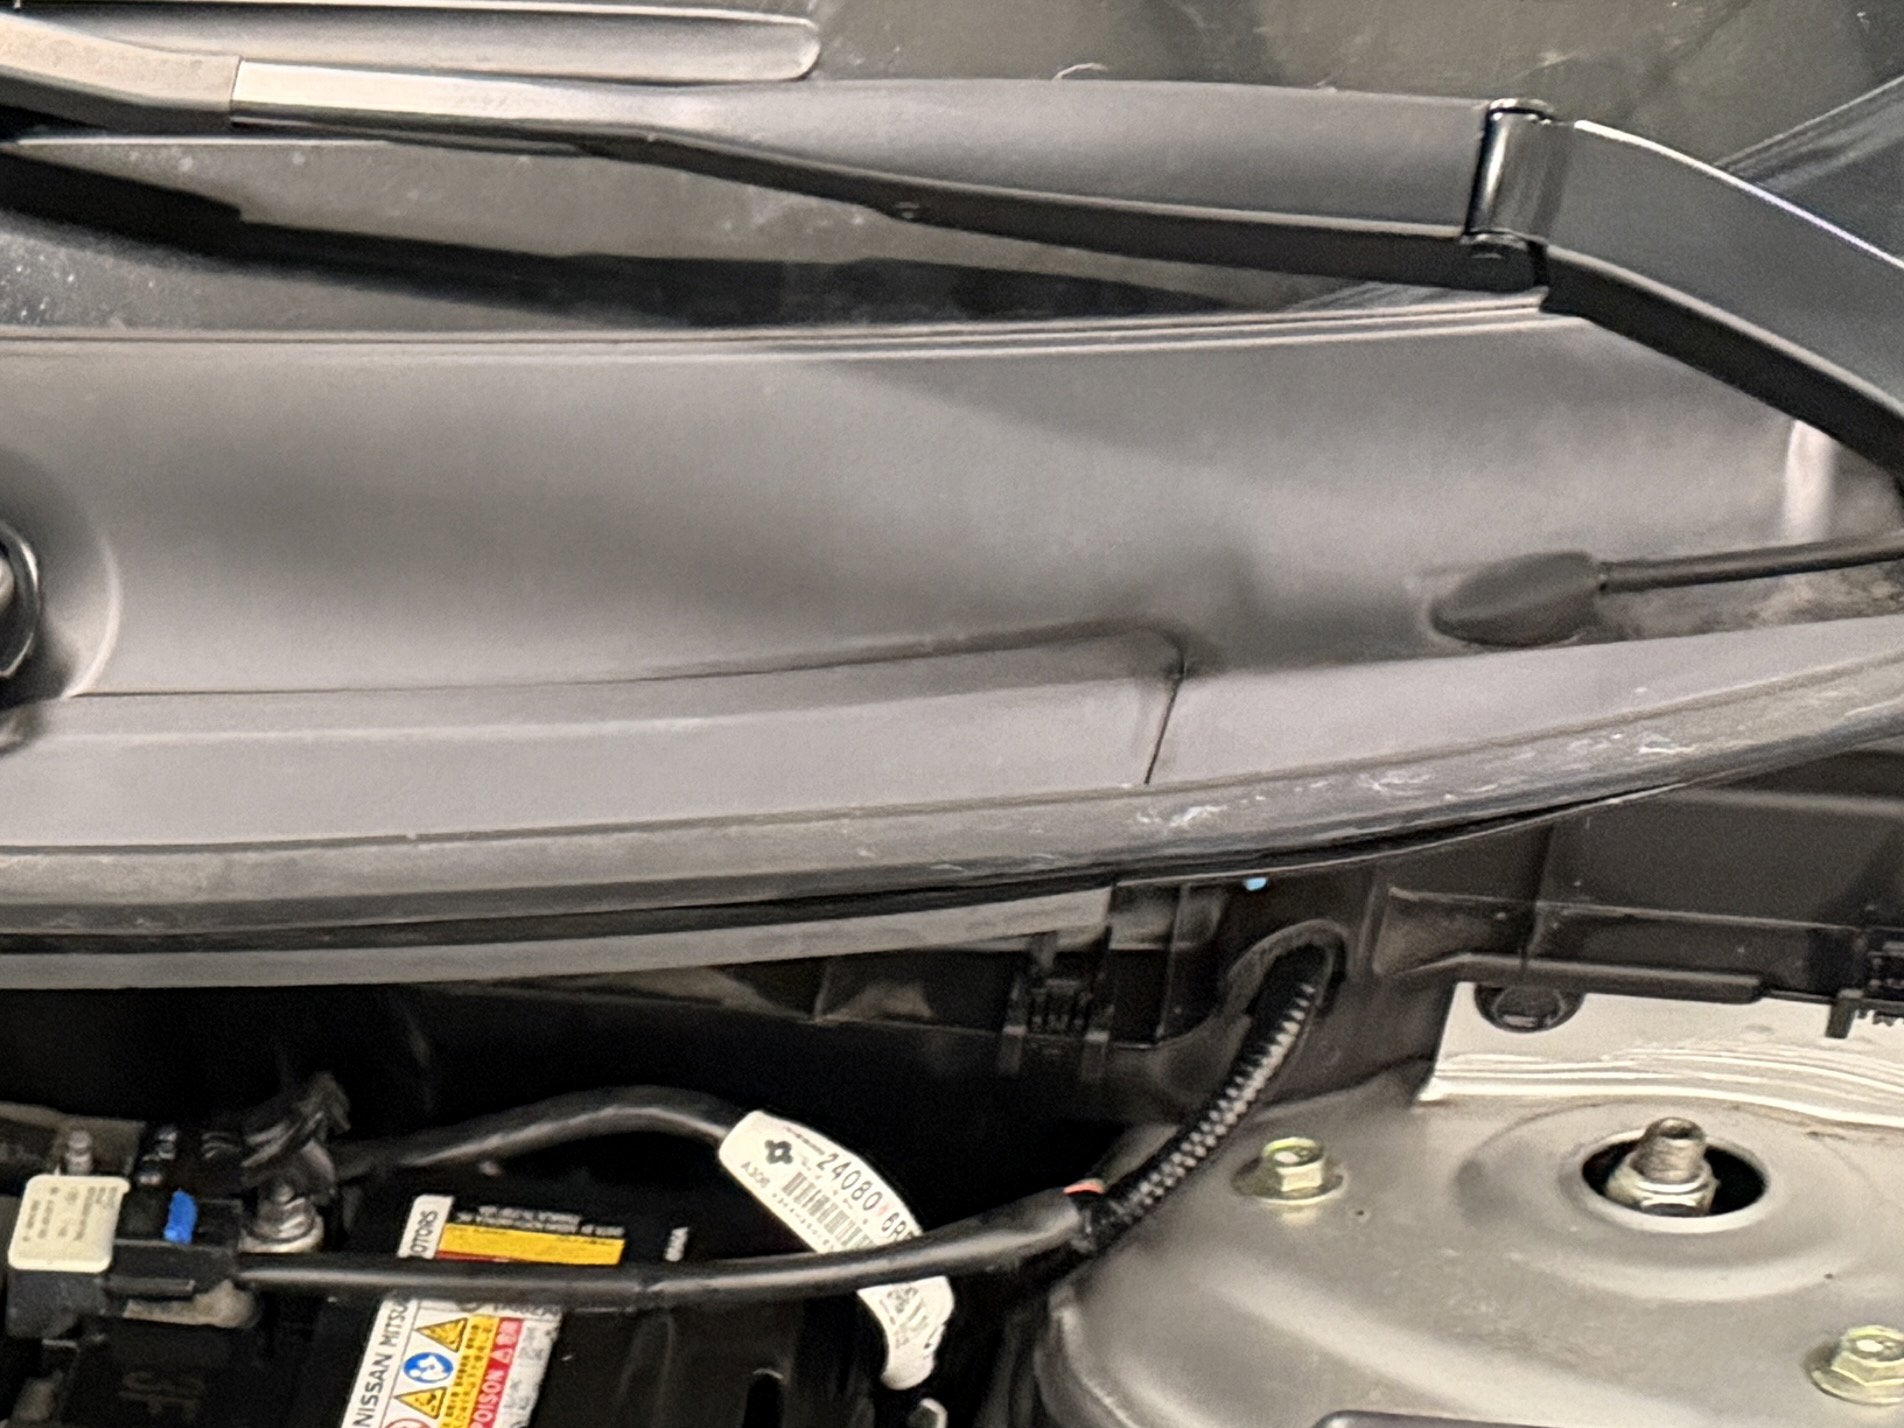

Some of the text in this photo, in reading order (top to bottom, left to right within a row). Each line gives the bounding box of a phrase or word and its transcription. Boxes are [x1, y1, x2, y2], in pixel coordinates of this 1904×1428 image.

[817, 1153, 882, 1211] 24080
[353, 1356, 392, 1427] NISSAN
[380, 1300, 409, 1348] MITSU
[410, 1210, 439, 1253] OTORS
